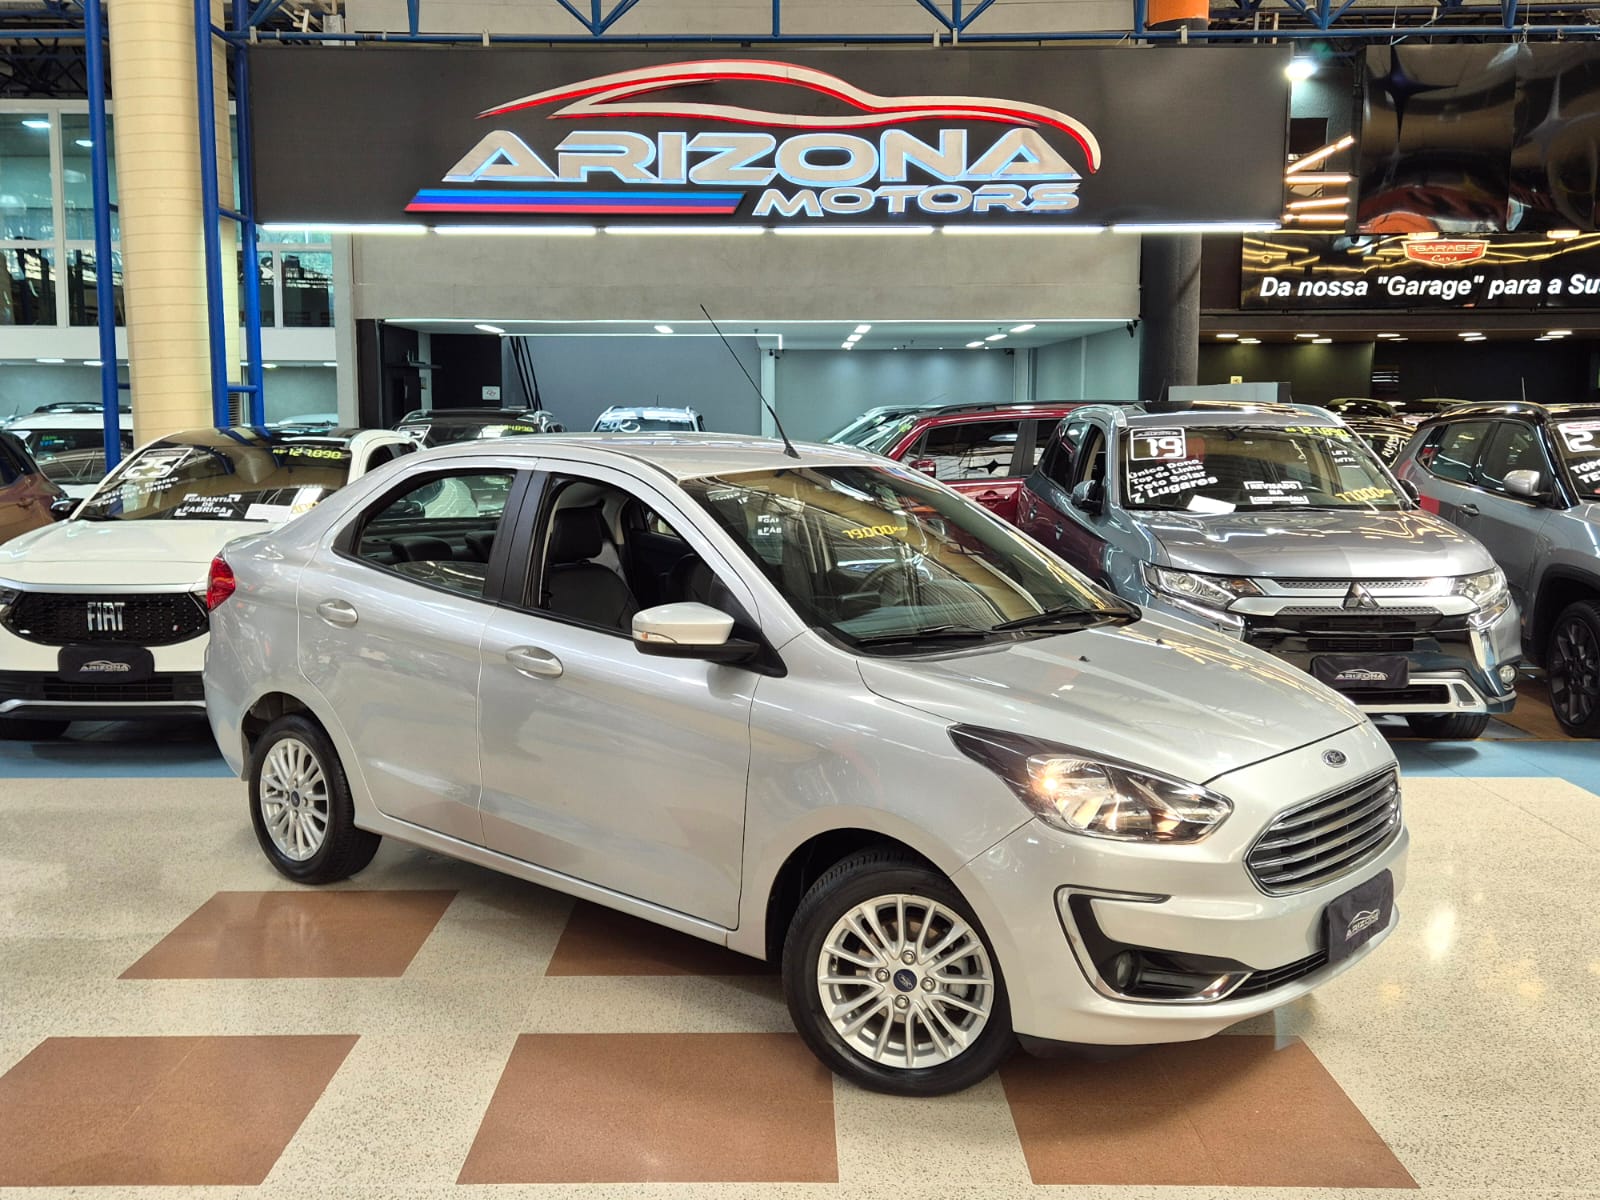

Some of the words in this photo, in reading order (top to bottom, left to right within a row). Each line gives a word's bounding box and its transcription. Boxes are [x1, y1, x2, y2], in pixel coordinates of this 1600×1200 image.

[441, 127, 1083, 187] ARIZONA
[752, 183, 1081, 217] MOTORS
[1408, 244, 1481, 252] GARAGE
[1259, 276, 1291, 297] Da
[1297, 280, 1369, 297] nossa
[1377, 275, 1484, 300] "Garage"
[1488, 278, 1541, 298] para
[1548, 278, 1562, 295] a
[1567, 273, 1600, 295] Su
[1146, 438, 1183, 457] 19
[124, 458, 177, 478] 25
[1130, 474, 1153, 485] Top
[1171, 464, 1204, 475] Linha
[145, 477, 179, 488] Dono
[1134, 480, 1167, 492] Teto
[1169, 471, 1207, 483] Solar
[1146, 476, 1219, 498] Lugares
[96, 496, 117, 507] Top
[138, 483, 172, 494] Linha
[87, 602, 125, 631] FIAT
